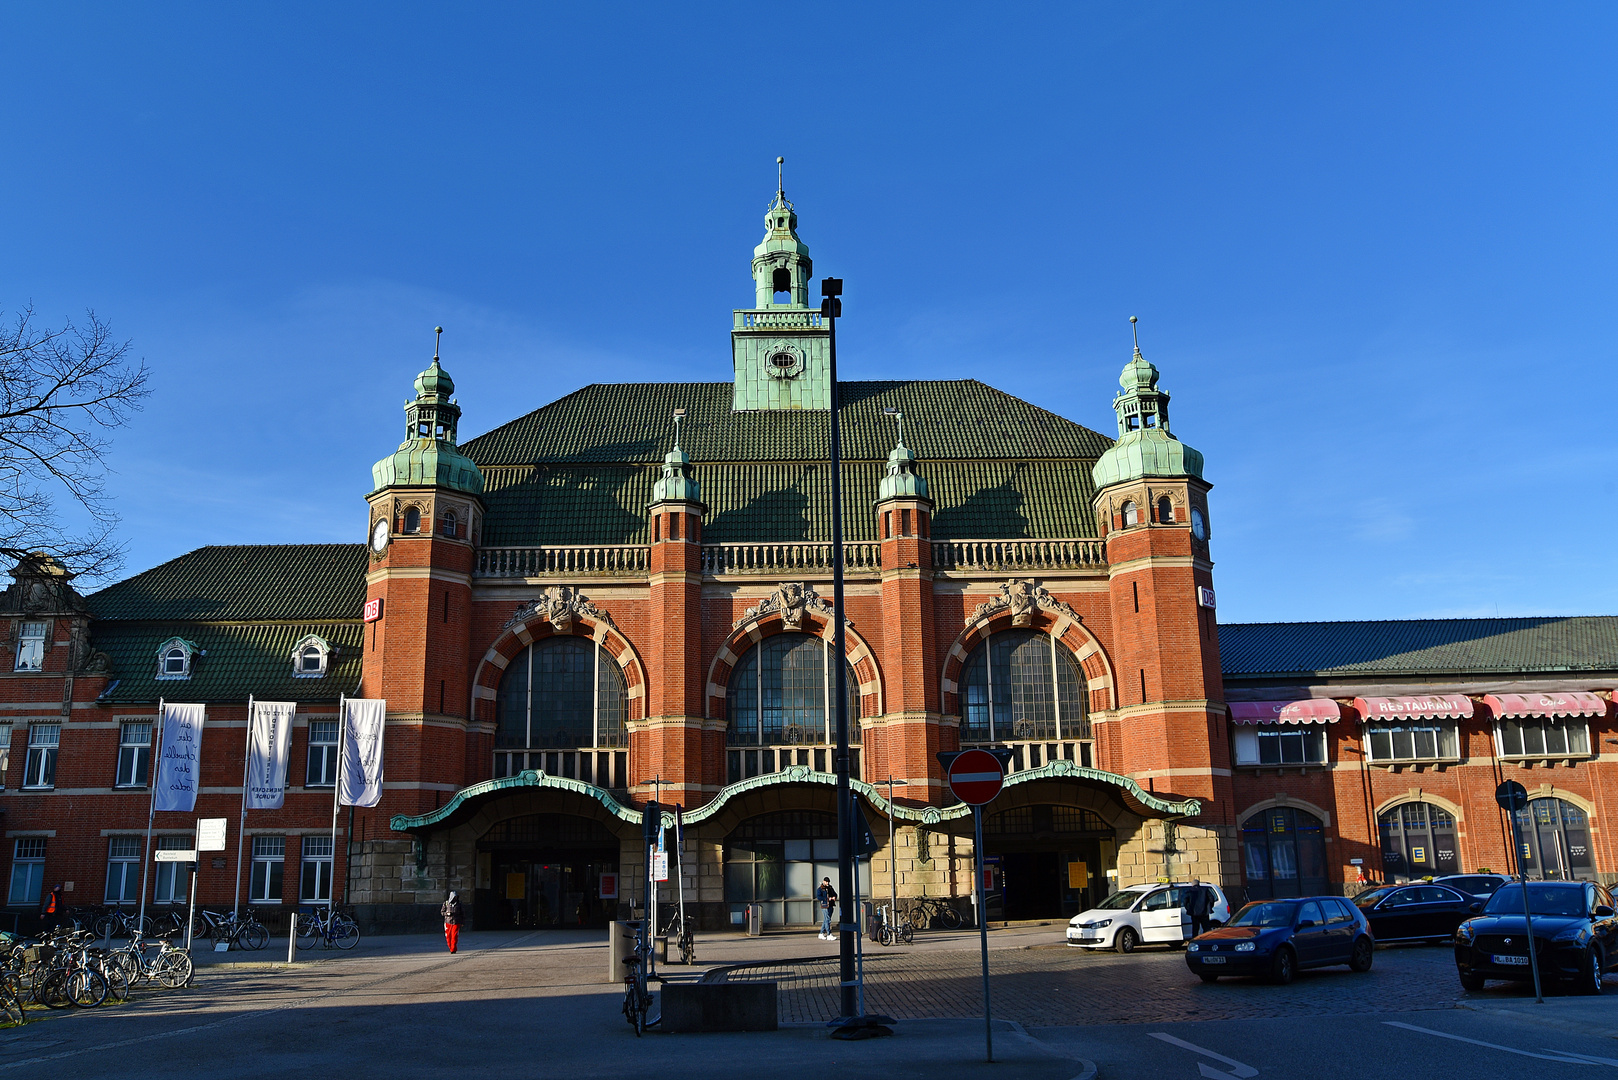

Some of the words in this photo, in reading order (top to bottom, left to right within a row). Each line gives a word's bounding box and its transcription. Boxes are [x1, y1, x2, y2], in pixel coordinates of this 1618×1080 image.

[1203, 590, 1215, 605] DB
[366, 602, 377, 618] DB
[1414, 849, 1424, 858] E
